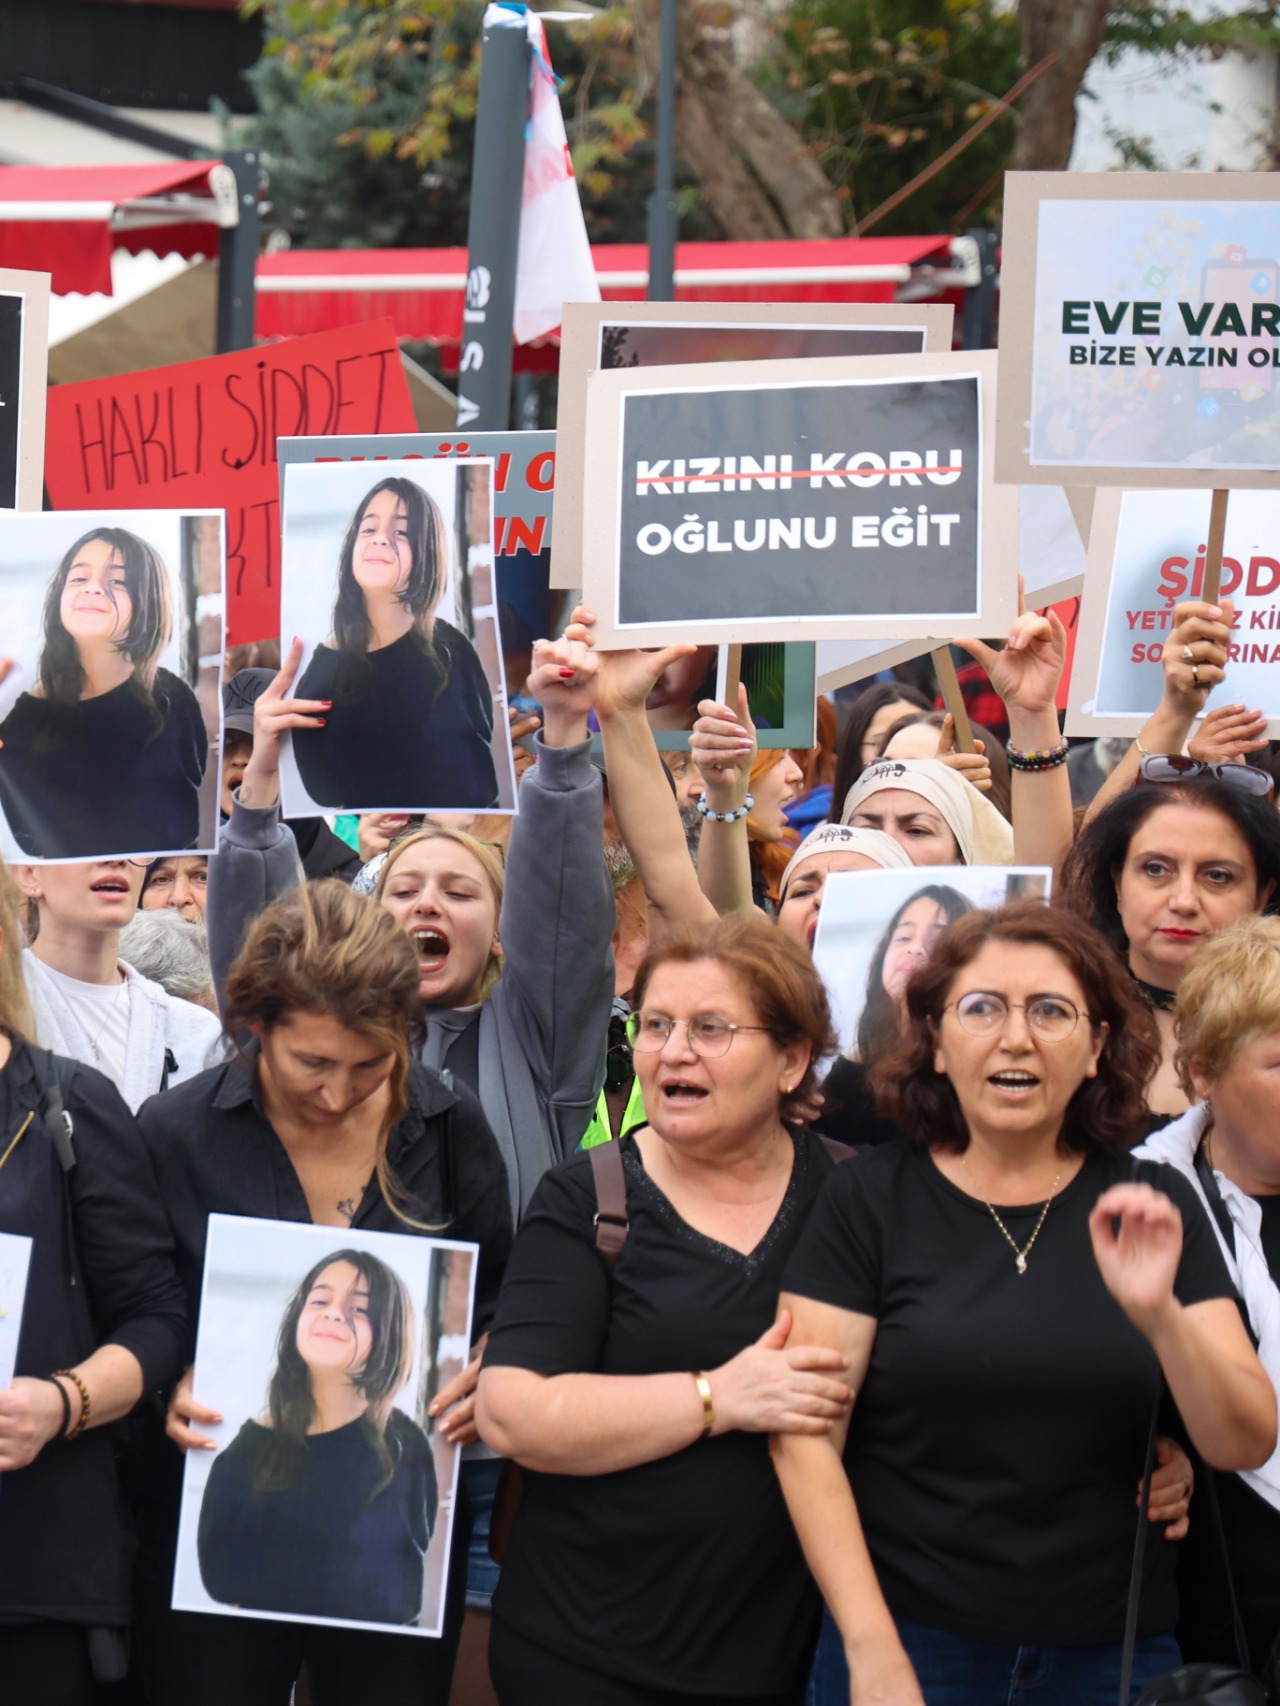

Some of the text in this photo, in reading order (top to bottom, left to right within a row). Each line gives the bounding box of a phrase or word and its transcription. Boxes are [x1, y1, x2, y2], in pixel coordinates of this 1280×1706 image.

[1062, 301, 1161, 335] EVE
[1070, 339, 1136, 366] BİZE
[1145, 346, 1238, 367] YAZIN
[76, 383, 202, 493] HAKLI
[636, 449, 963, 495] KIZINI KORU
[636, 504, 961, 556] OĞLUNU EĞİT
